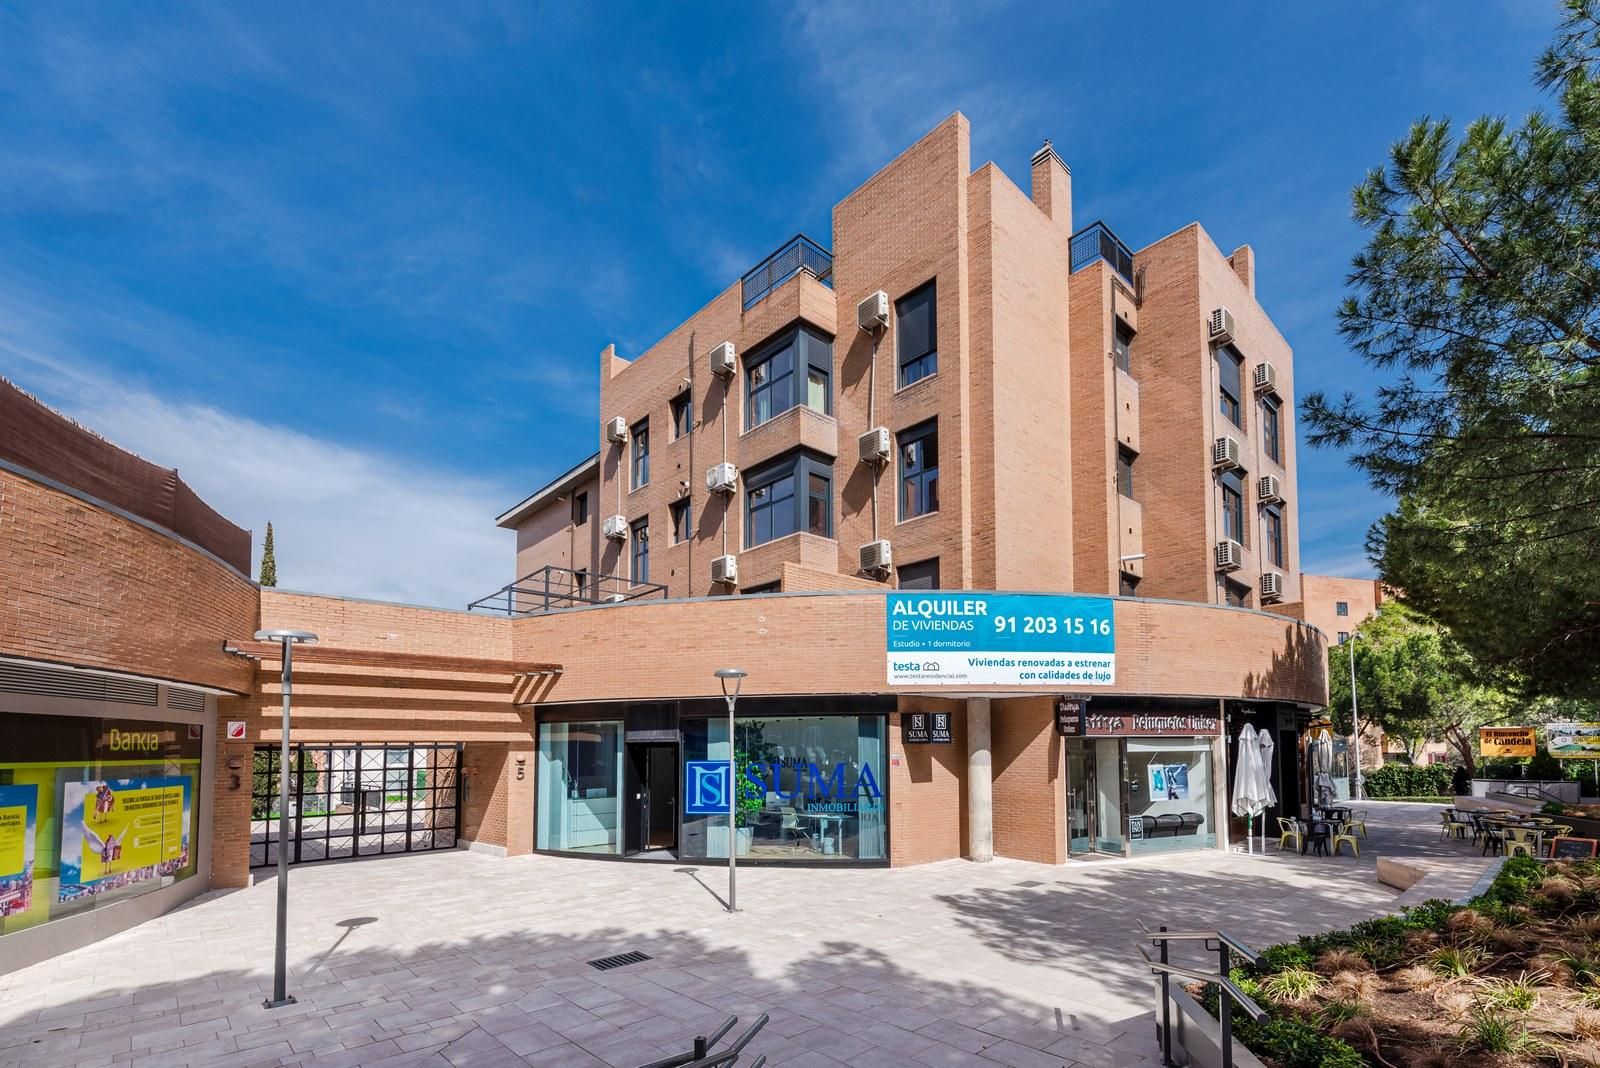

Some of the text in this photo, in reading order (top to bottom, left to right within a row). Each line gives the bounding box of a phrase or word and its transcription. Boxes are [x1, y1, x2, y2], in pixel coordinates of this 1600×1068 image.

[893, 600, 987, 618] ALQUILER
[893, 620, 974, 631] DE VIVIENDAS
[994, 616, 1110, 635] 91 203 15 16
[894, 640, 920, 648] Estudio
[933, 640, 971, 648] dormitorio
[893, 662, 920, 672] testa
[968, 658, 1015, 667] Viviendas
[1018, 658, 1065, 667] renovadas
[1074, 659, 1111, 668] estrenar
[1038, 671, 1080, 680] calidades
[1082, 671, 1093, 680] de
[1095, 671, 1111, 681] lujo
[908, 730, 928, 738] SUMA
[932, 730, 950, 738] SUMA
[110, 728, 159, 751] Bankia
[1493, 737, 1532, 746] Candela
[516, 767, 525, 781] 5
[746, 762, 884, 800] SUMA
